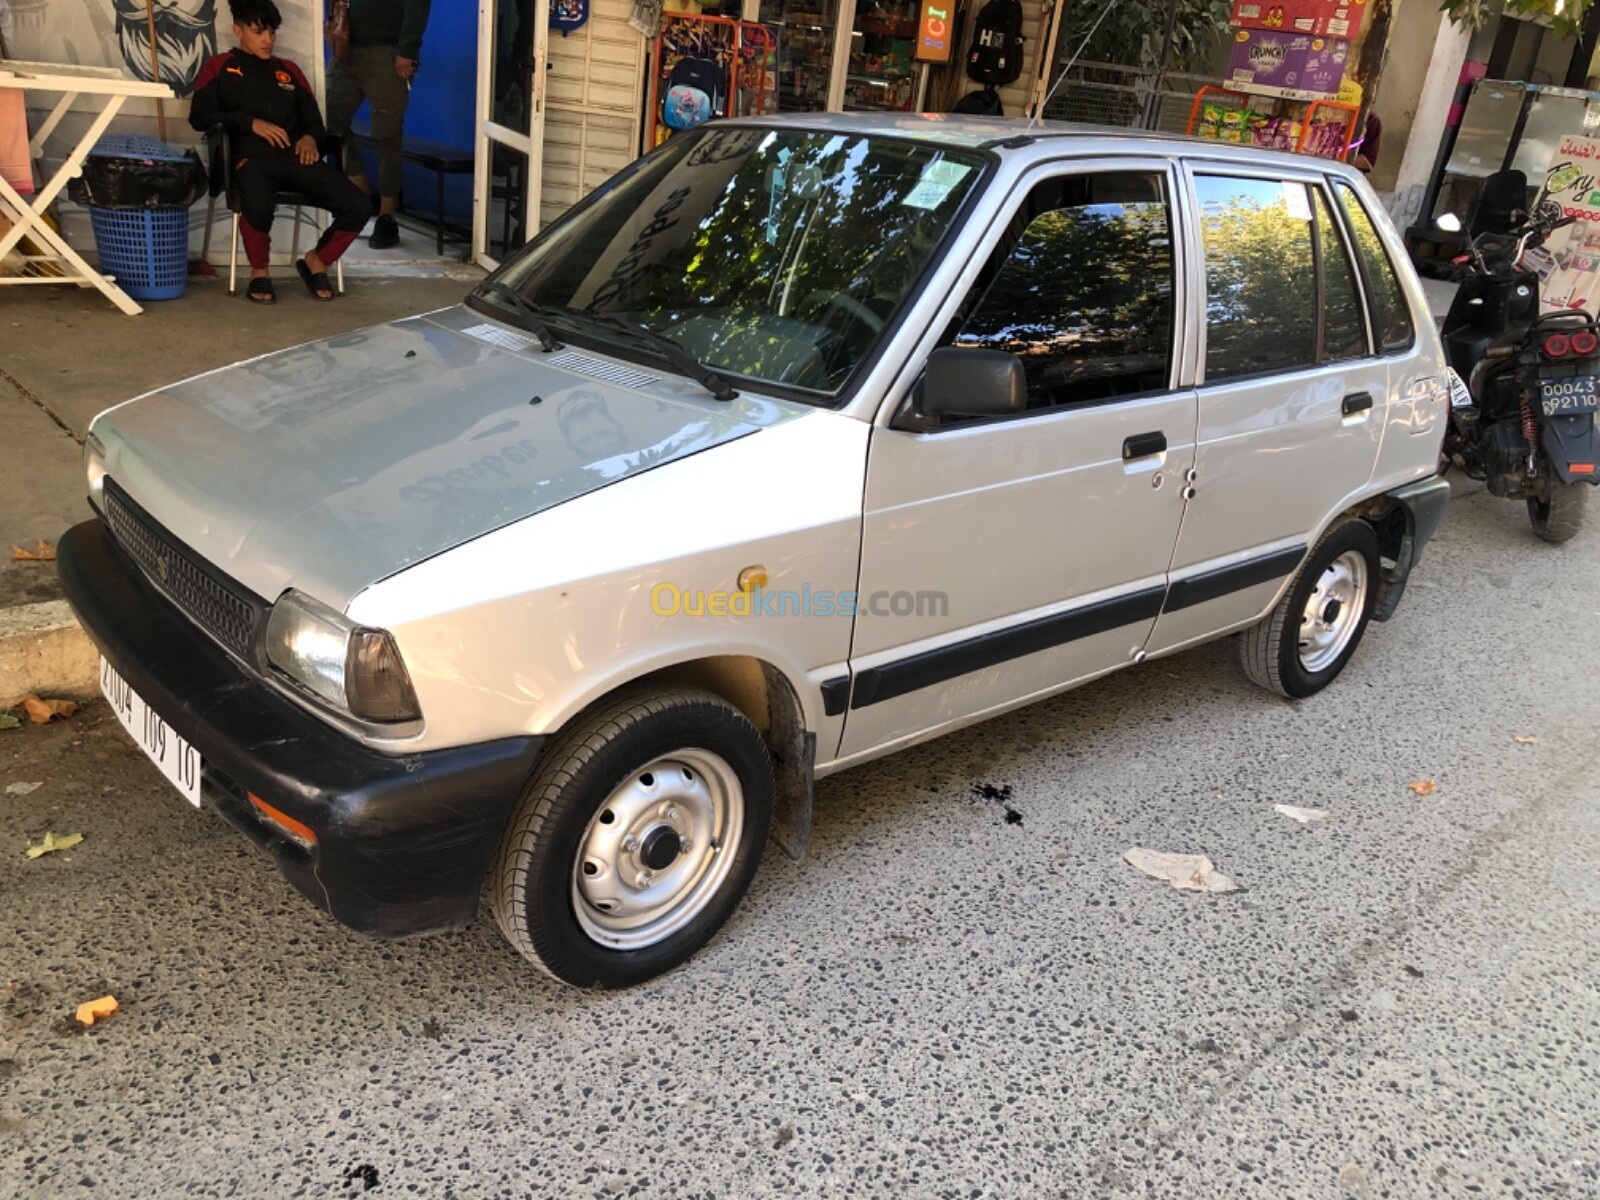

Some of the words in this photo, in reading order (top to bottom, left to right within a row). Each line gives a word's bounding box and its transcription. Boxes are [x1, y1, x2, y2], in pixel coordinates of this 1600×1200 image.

[925, 6, 947, 50] ICI
[1543, 381, 1595, 396] 00043
[144, 703, 166, 763] 109
[176, 731, 195, 791] 10
